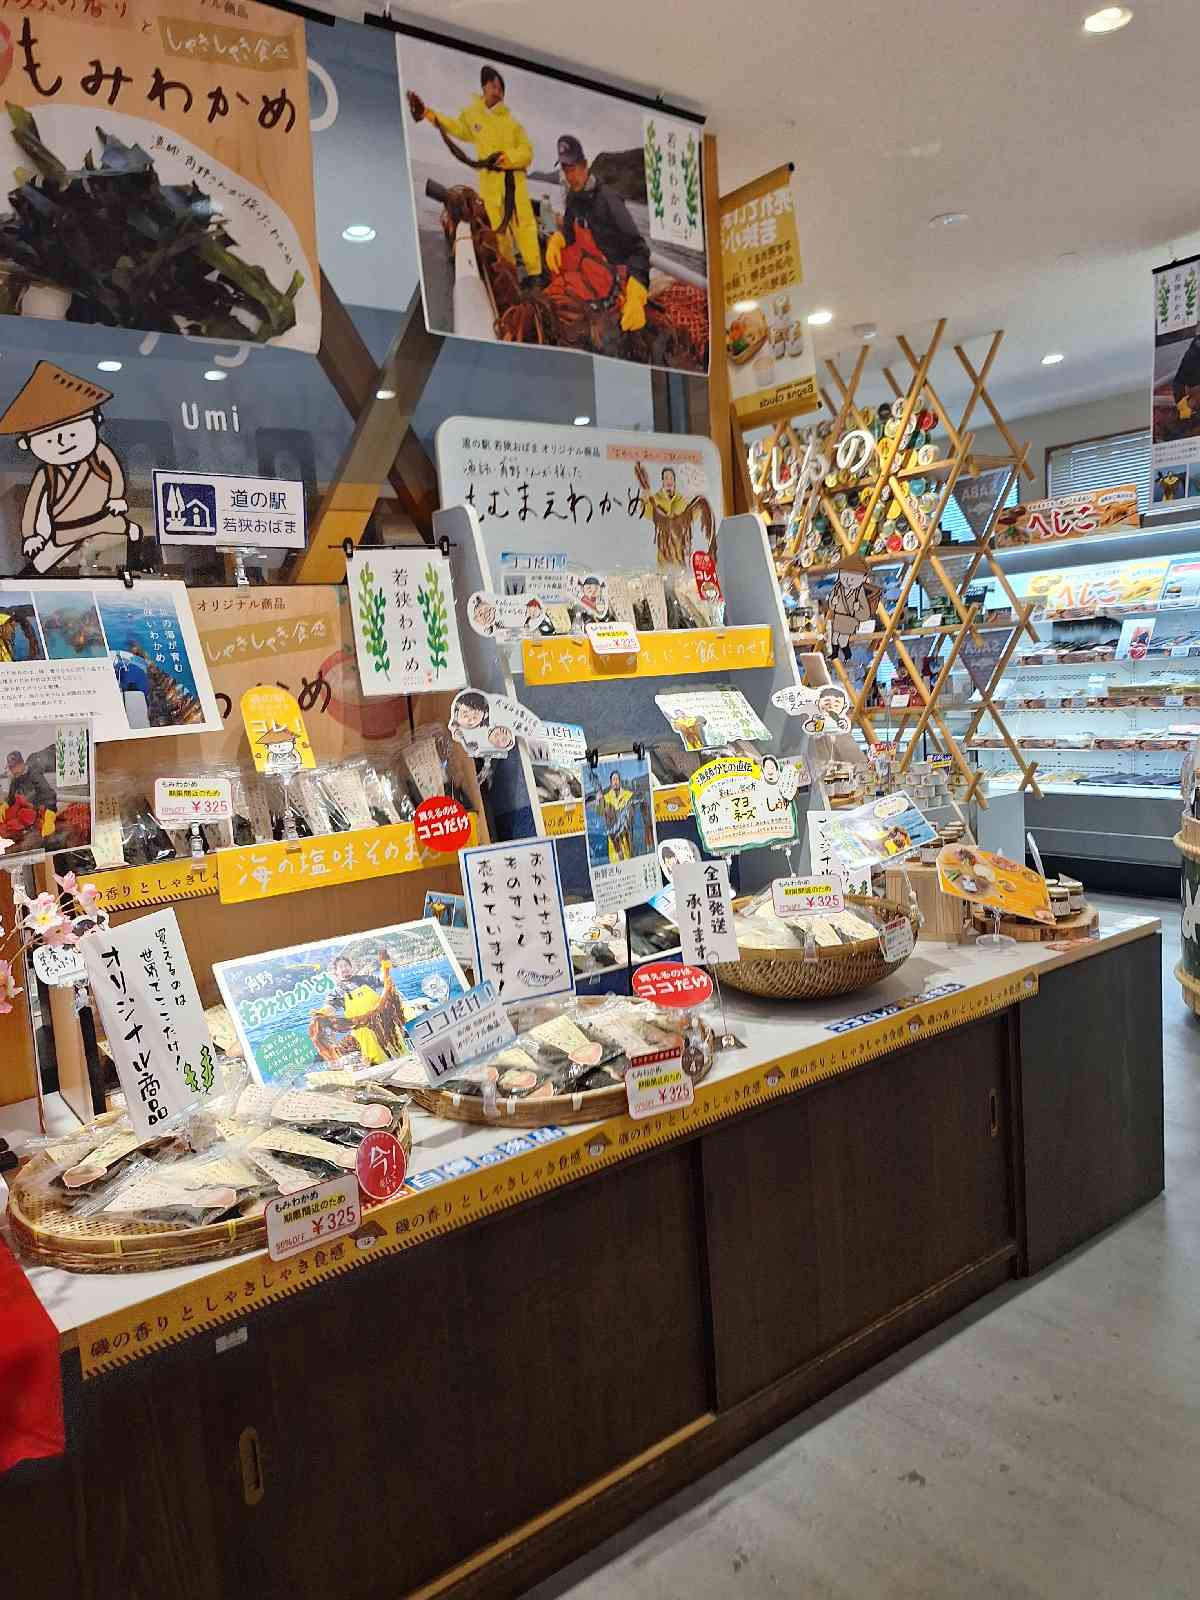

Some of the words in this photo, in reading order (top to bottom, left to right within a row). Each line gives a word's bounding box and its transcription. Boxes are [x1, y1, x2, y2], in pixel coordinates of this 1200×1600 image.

[17, 16, 297, 133] もみわかめ
[181, 401, 240, 433] Umi
[230, 488, 287, 511] 道の駅
[222, 517, 297, 535] 若狭おばま
[1028, 504, 1096, 537] へしこ
[197, 597, 287, 611] オリジナル商品
[391, 567, 421, 673] 若狭わかめ
[191, 799, 229, 814] ¥325
[731, 796, 750, 809] マヨ
[416, 815, 470, 841] ココだけ
[703, 865, 728, 935] 全国発送
[806, 894, 841, 909] ¥325
[686, 893, 707, 961] 承ります
[155, 926, 188, 1007] 買えるのは
[636, 974, 709, 1000] ココだけ
[415, 981, 495, 1041] ココだけ!
[101, 945, 168, 1127] オリジナル商品
[275, 1190, 319, 1212] もみわかめ
[283, 1194, 346, 1225] 期限間近のため
[311, 1205, 357, 1235] ¥325
